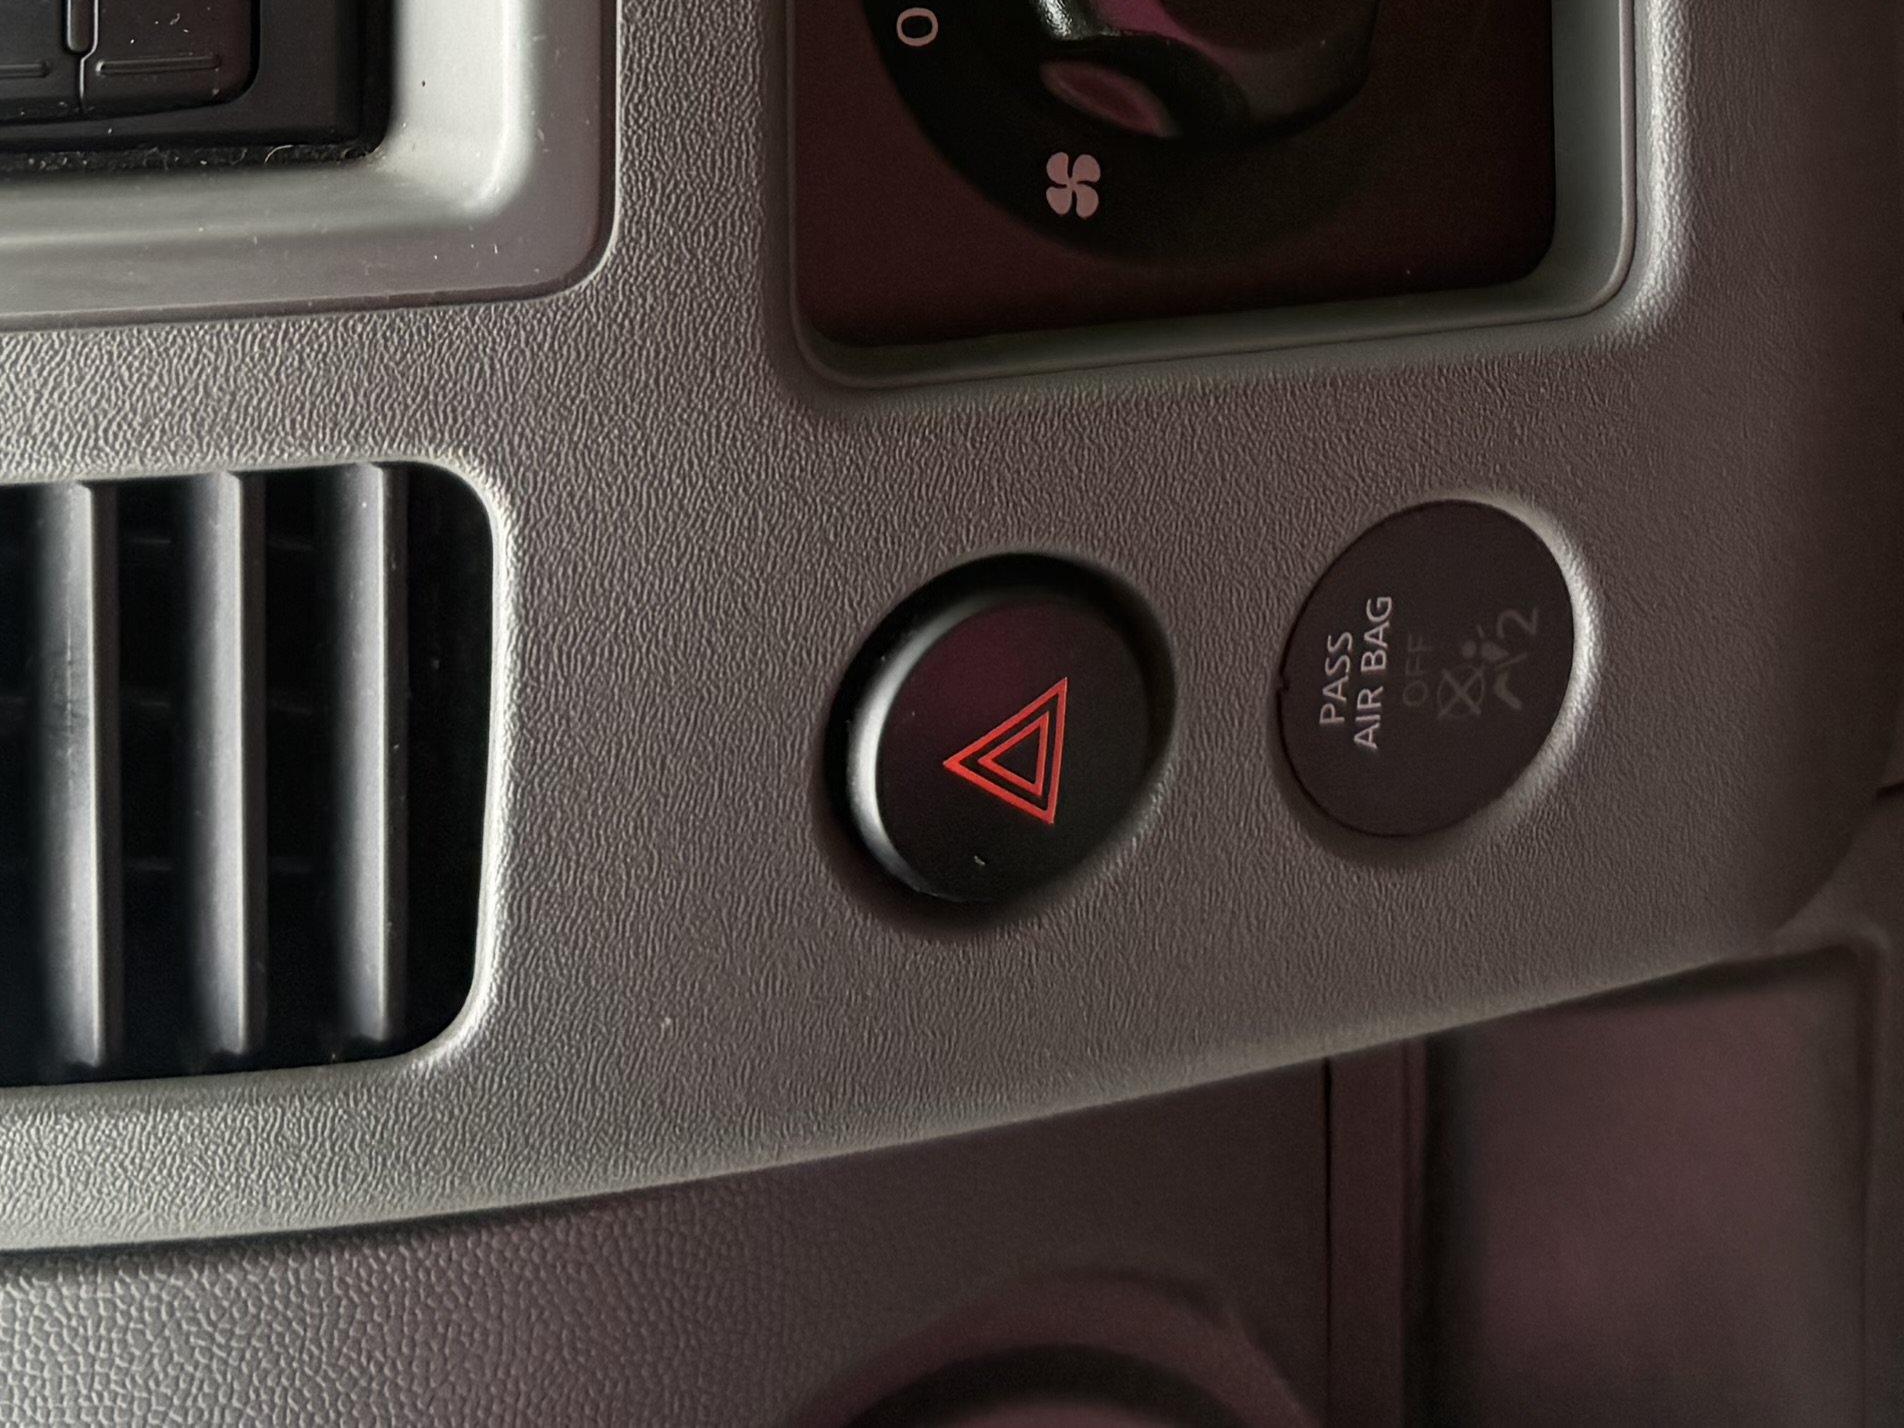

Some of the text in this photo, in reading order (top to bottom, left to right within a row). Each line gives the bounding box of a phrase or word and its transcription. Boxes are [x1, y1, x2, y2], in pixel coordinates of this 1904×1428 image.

[897, 8, 938, 46] 0
[1320, 632, 1352, 723] PASS
[1354, 597, 1391, 748] AIR BAG
[1403, 634, 1428, 706] OFF
